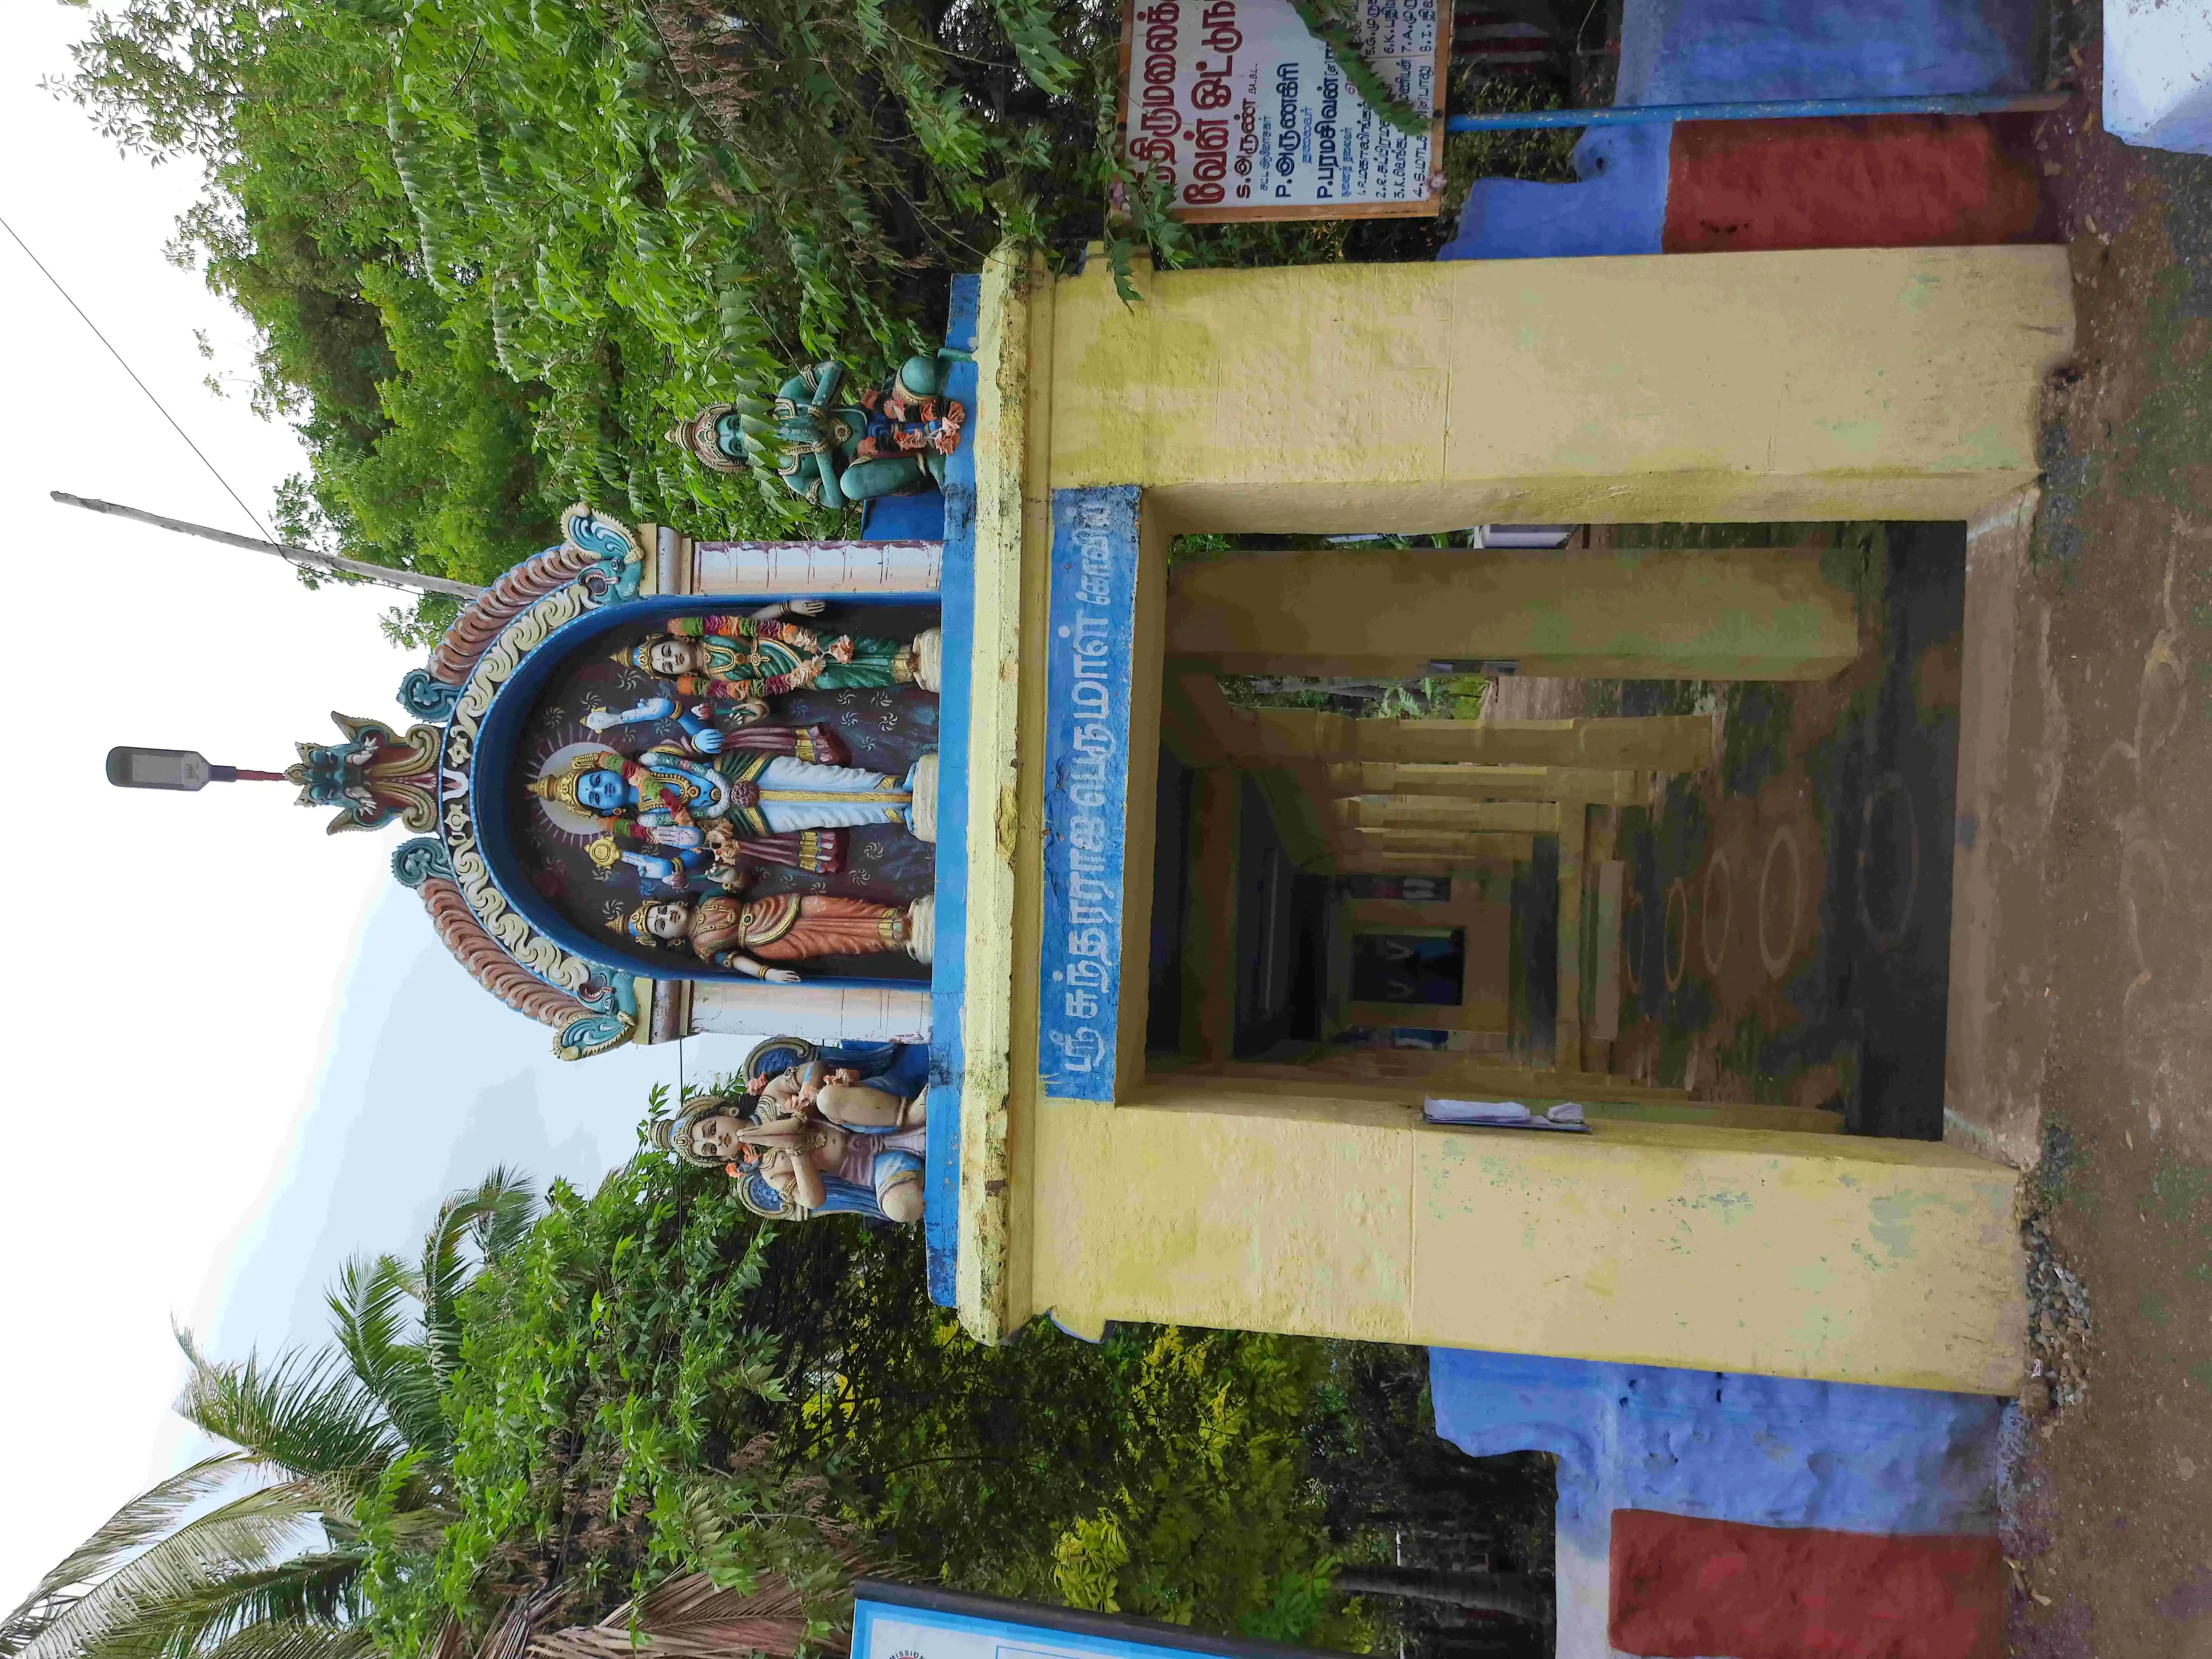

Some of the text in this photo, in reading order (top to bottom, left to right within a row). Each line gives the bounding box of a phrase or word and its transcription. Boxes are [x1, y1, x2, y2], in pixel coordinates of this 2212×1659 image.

[1182, 0, 1243, 205] வேன் ஓட்டுந
[1300, 106, 1313, 164] தலைவர்
[1260, 171, 1269, 191] சட்ட
[1057, 609, 1117, 806] பெருமாள்
